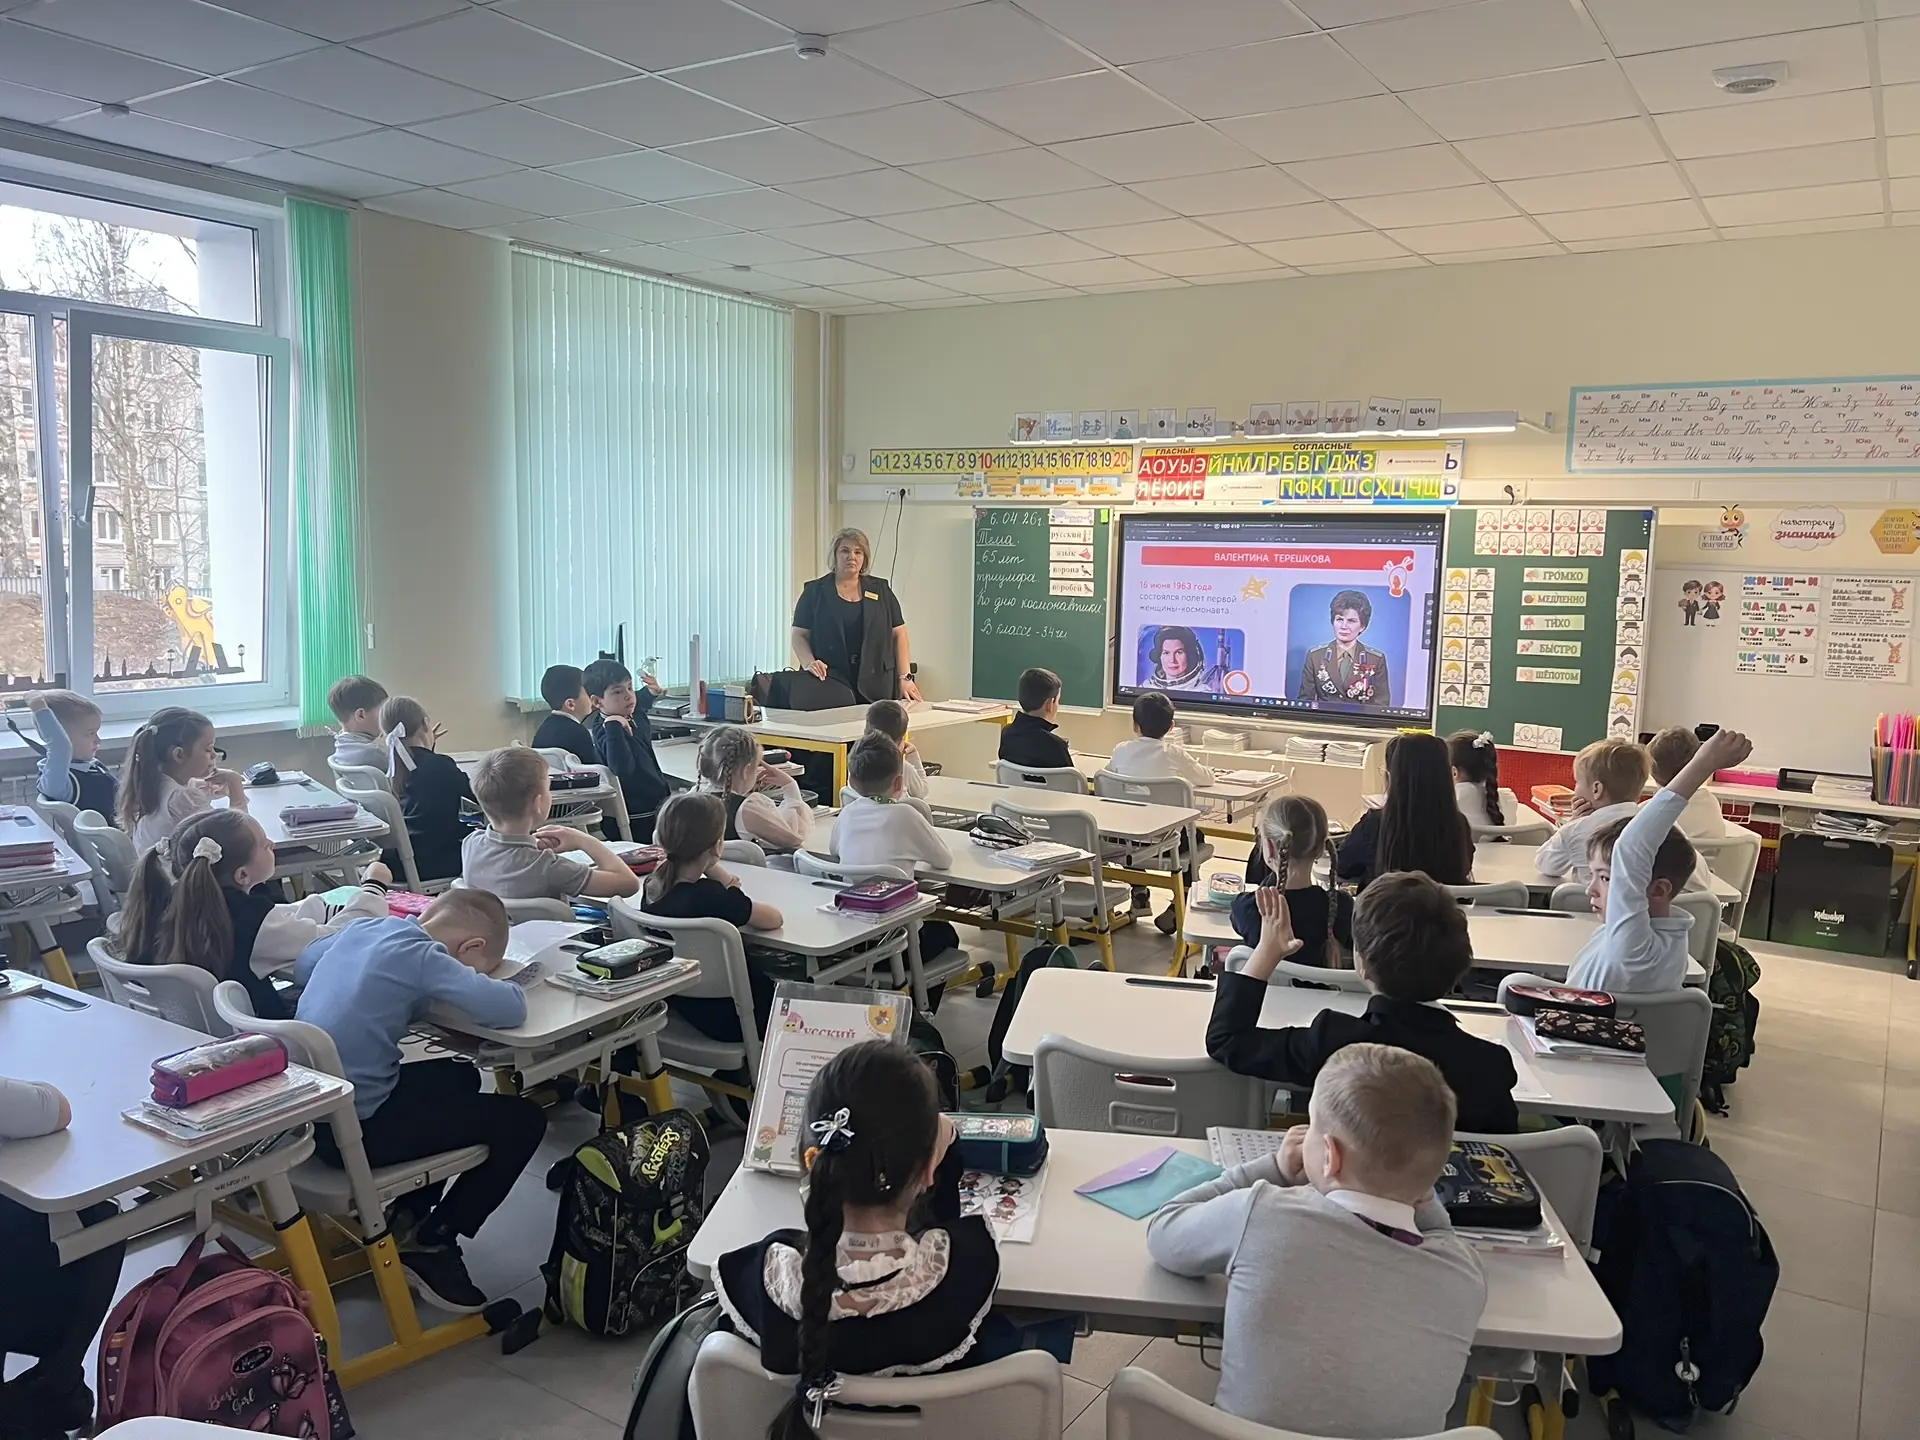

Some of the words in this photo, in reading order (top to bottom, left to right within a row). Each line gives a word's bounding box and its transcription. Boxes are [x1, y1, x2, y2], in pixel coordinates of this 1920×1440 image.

[1155, 447, 1196, 455] ГЛАСНЫЕ
[1293, 442, 1353, 450] СОГЛАСНЫЕ
[1780, 519, 1836, 531] навстречу
[1051, 529, 1082, 540] русский
[1774, 530, 1837, 541] знаниям
[1214, 552, 1269, 563] ВАЛЕНТИНА
[1273, 553, 1332, 565] ТЕРЕШКОВА
[1542, 570, 1584, 581] ГРОМКО
[1173, 581, 1192, 590] 1963
[1193, 583, 1212, 591] года
[1140, 593, 1180, 601] состоялся
[1206, 594, 1237, 604] первой
[1537, 594, 1585, 604] МЕДЛЕННО
[994, 597, 1016, 614] дню
[1806, 603, 1816, 613] А
[981, 618, 993, 634] В
[996, 622, 1032, 637] классе
[1544, 618, 1571, 628] ТИХО
[1804, 628, 1814, 638] У
[1539, 643, 1578, 655] БЫСТРО
[1535, 670, 1579, 681] ШЁПОТОМ
